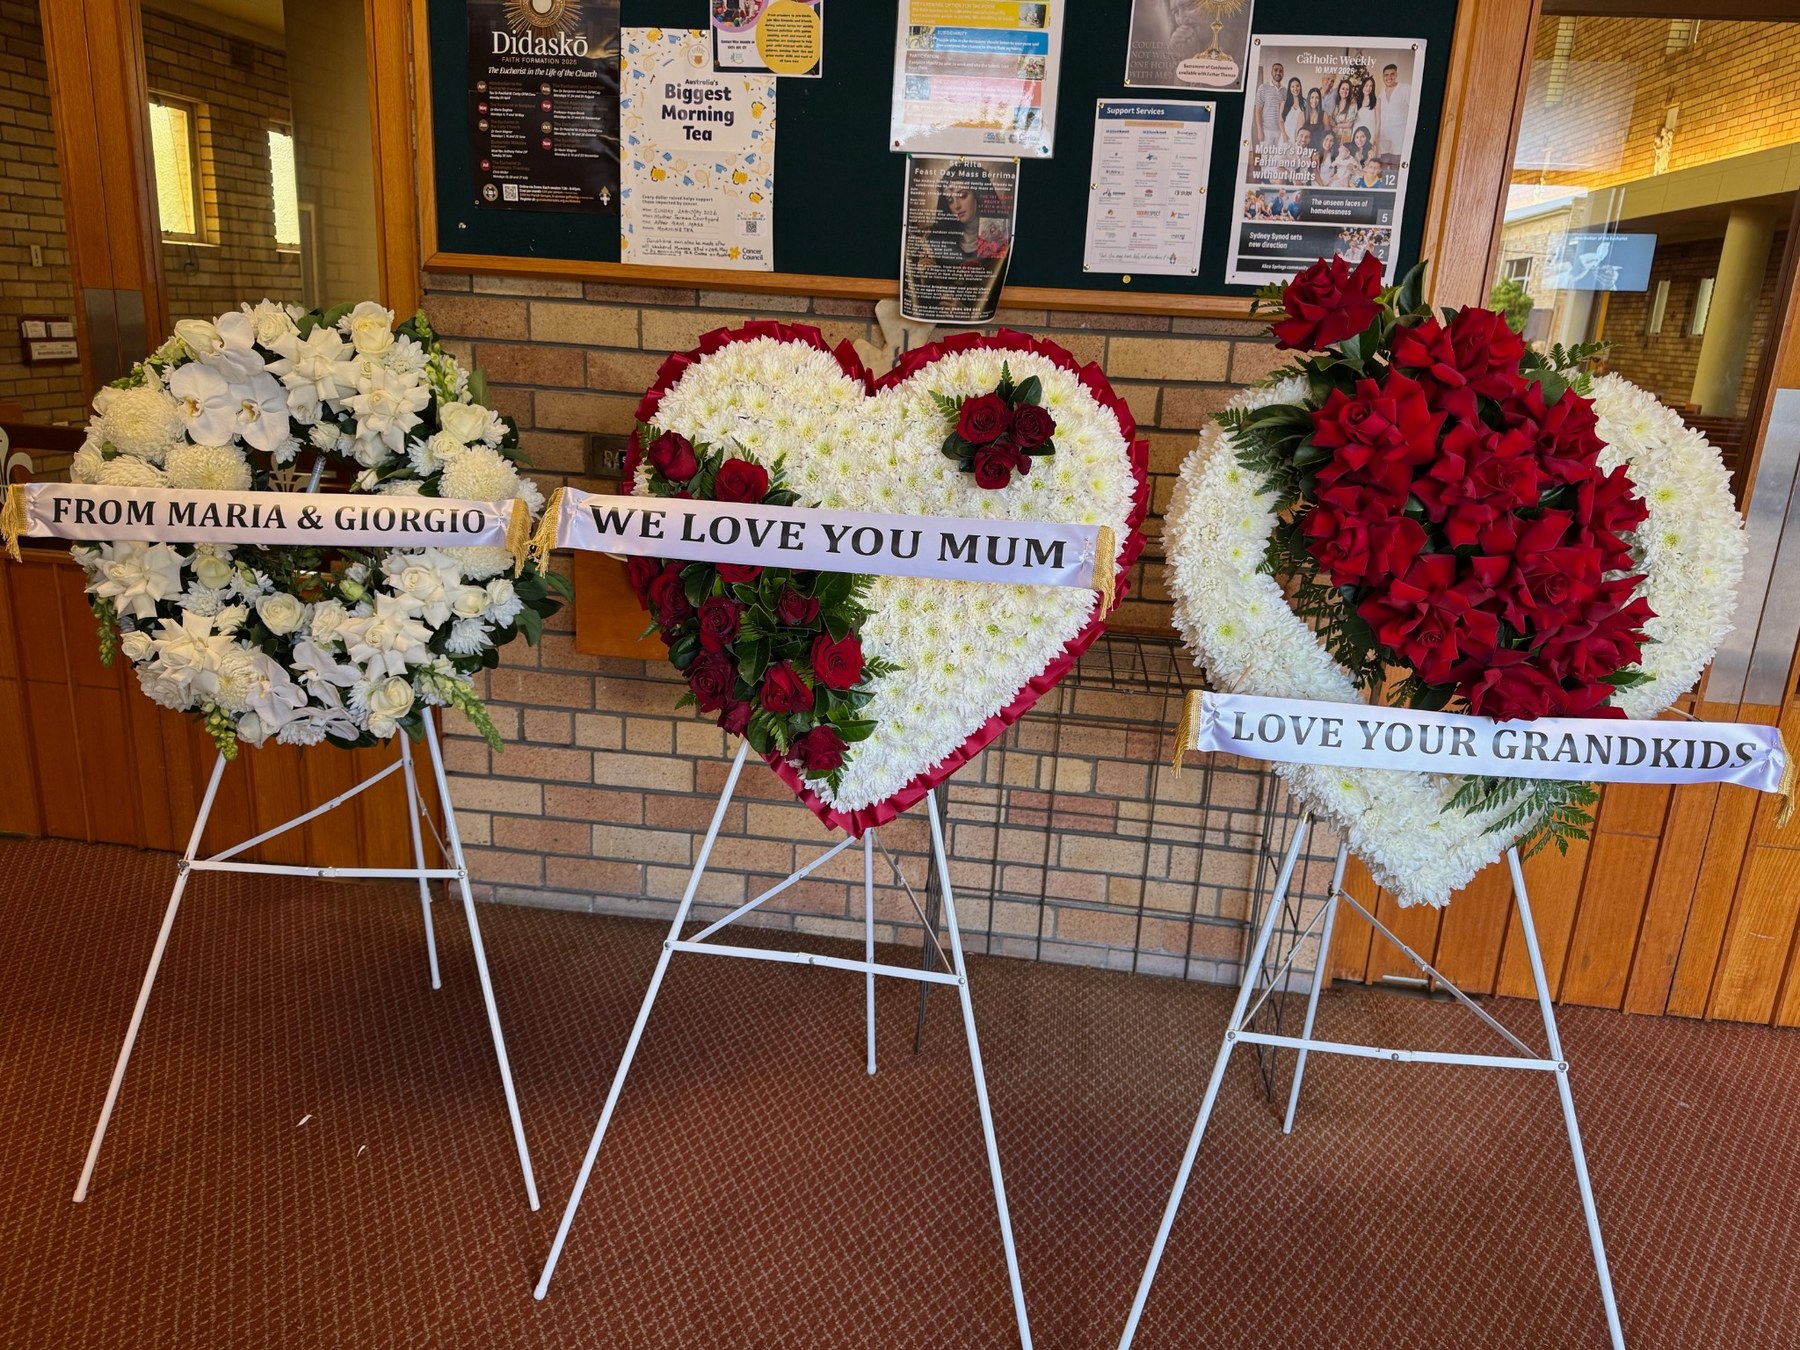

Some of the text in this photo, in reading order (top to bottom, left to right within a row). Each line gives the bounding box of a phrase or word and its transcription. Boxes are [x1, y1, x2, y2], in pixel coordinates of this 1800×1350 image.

[492, 30, 588, 57] Didaskō
[1297, 55, 1376, 68] Catholic Weekly
[545, 68, 556, 77] Life
[557, 69, 564, 77] of
[1324, 66, 1338, 74] MAY
[1339, 67, 1354, 75] 2026
[665, 83, 731, 104] Biggest
[662, 104, 734, 126] Morning
[1107, 107, 1134, 116] Support
[683, 126, 712, 141] Tea
[1256, 144, 1317, 157] Mother's Day:
[1254, 157, 1317, 168] Faith and love
[1253, 170, 1316, 181] without limits
[1385, 174, 1395, 185] 12
[1310, 207, 1351, 216] homelessness
[1382, 213, 1388, 223] 5
[1250, 232, 1270, 240] Sydney
[1378, 249, 1384, 259] 2
[52, 498, 486, 534] FROM MARIA & GIORGIO
[589, 505, 1067, 568] WE LOVE YOU MUM
[1232, 711, 1757, 770] LOVE YOUR GRANDKIDS
